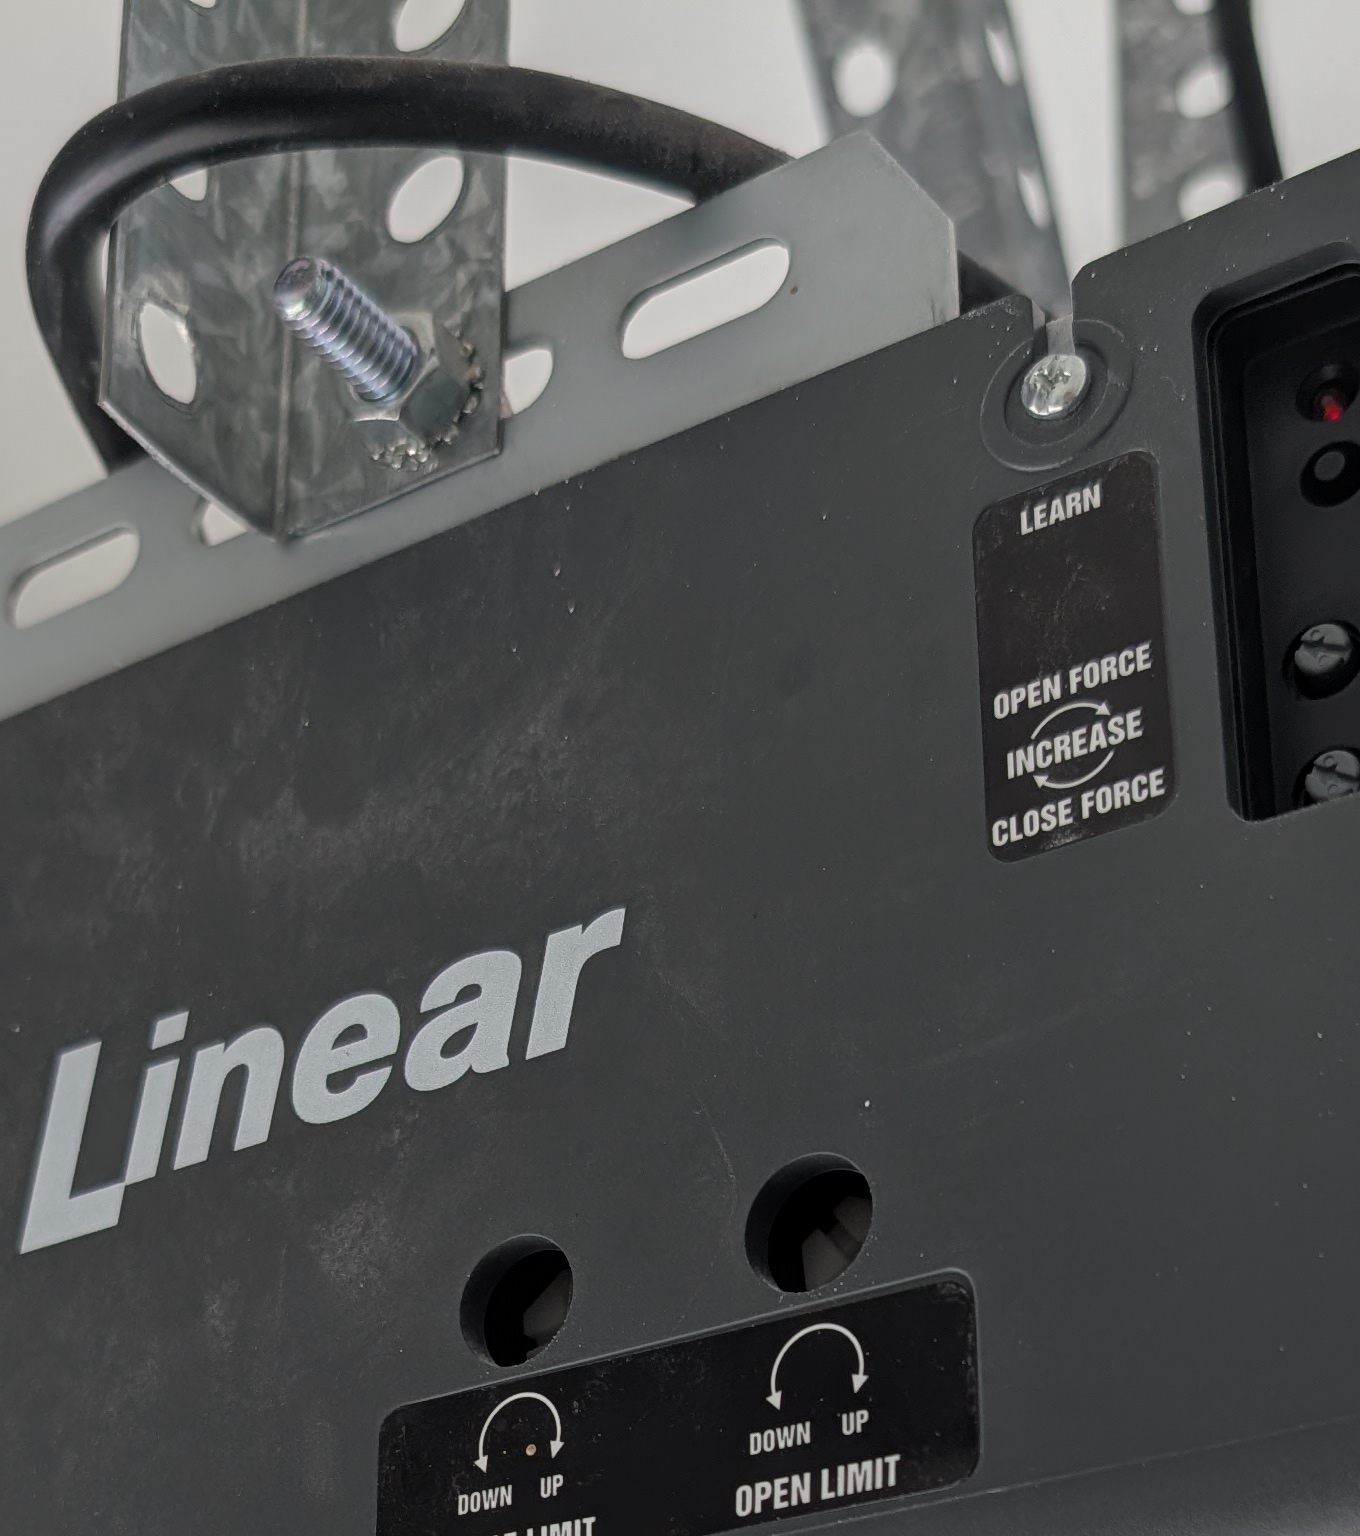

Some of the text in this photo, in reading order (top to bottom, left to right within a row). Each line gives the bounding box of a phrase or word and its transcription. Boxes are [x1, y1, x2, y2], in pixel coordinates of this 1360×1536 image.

[1020, 482, 1101, 536] LEARN
[993, 642, 1152, 719] OPEN FORCE
[1006, 709, 1143, 780] INCREASE
[991, 768, 1165, 847] CLOSE FORCE
[19, 907, 626, 1255] Linear
[749, 1421, 811, 1456] DOWN
[841, 1409, 869, 1436] UP
[457, 1484, 513, 1516] DOWN
[540, 1474, 564, 1499] UP
[735, 1454, 901, 1517] OPEN LIMIT
